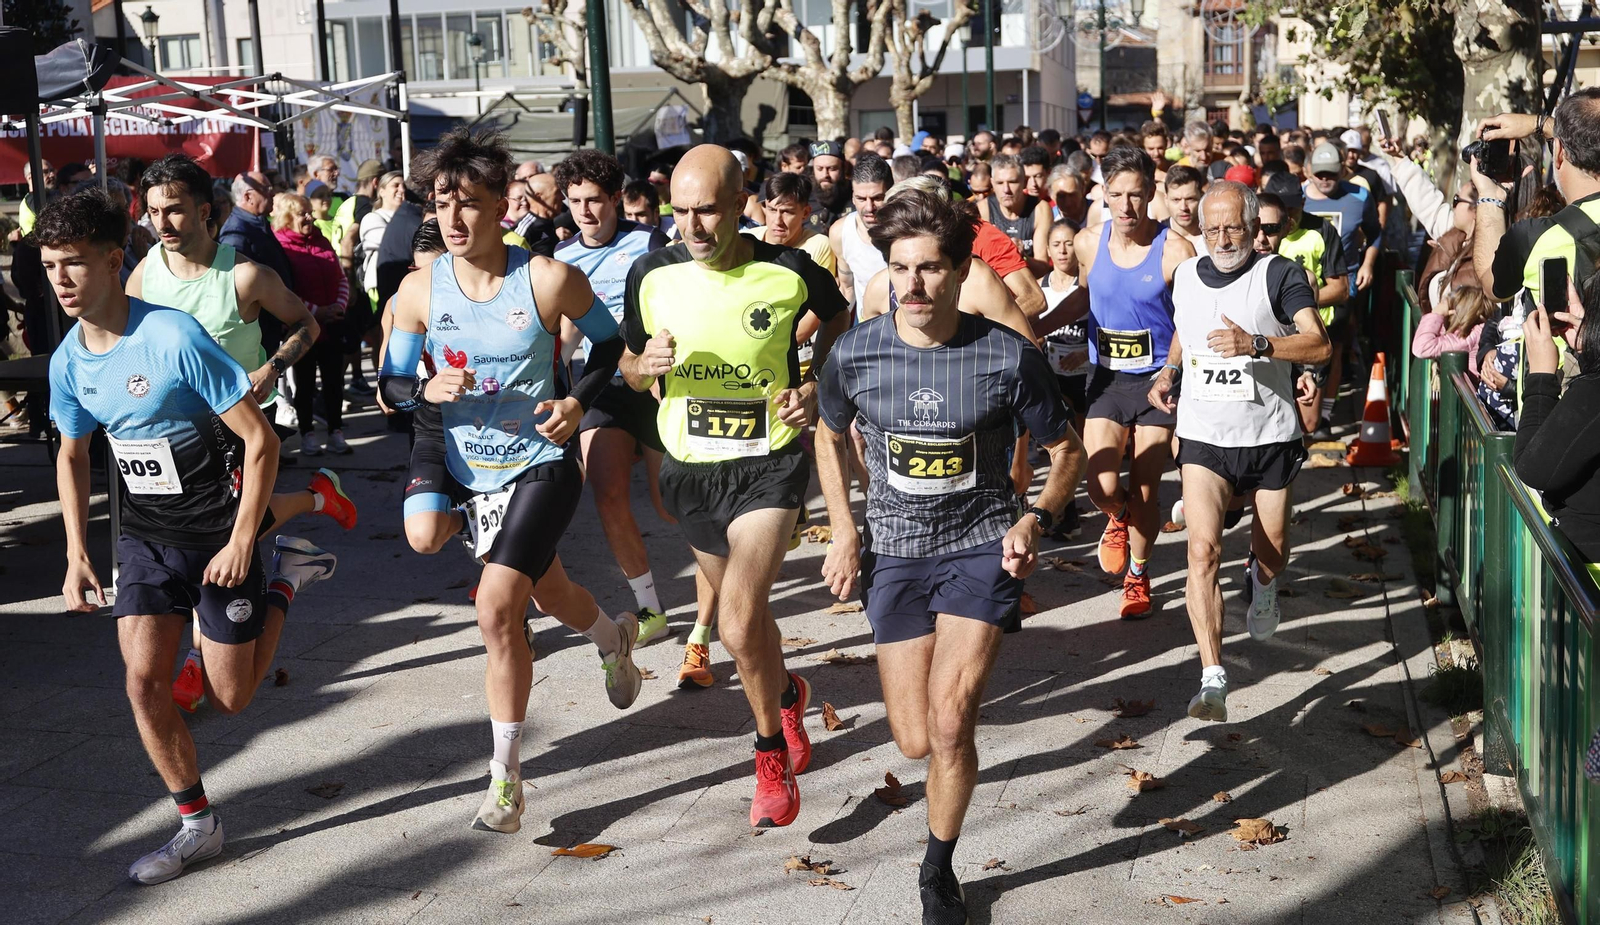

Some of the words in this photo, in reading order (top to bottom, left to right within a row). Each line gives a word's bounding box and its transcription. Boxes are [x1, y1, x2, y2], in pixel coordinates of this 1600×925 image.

[47, 119, 88, 137] POLA
[90, 116, 176, 136] SCLEROSE
[473, 354, 509, 364] Saunier
[510, 352, 536, 362] Duval
[1110, 343, 1142, 358] 170
[674, 363, 751, 381] AVEMPO
[1203, 369, 1242, 385] 742
[708, 417, 756, 437] 177
[898, 419, 911, 427] THE
[913, 420, 956, 429] COBARDES
[468, 432, 494, 440] RENAULT
[464, 442, 528, 456] RODOSA
[118, 458, 162, 477] 909
[475, 462, 521, 470] www.rodosa.com
[908, 457, 963, 477] 243
